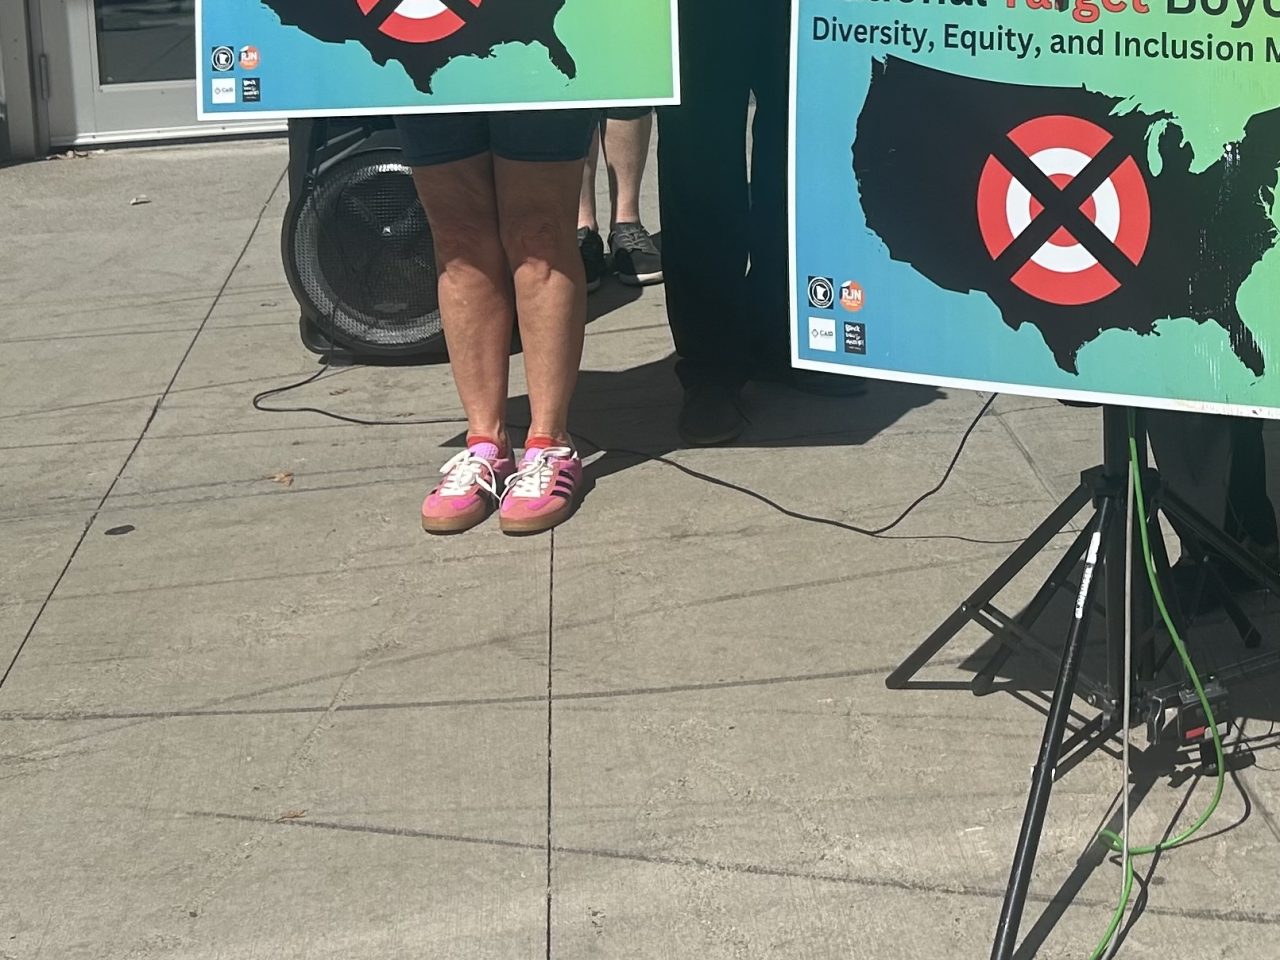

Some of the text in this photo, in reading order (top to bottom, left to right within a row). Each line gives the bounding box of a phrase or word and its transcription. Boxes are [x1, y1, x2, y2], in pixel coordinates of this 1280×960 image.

[811, 16, 935, 52] Diversity,
[944, 23, 1042, 59] Equity,
[1050, 29, 1103, 55] and
[1114, 31, 1254, 62] Inclusion
[842, 288, 862, 300] RJN
